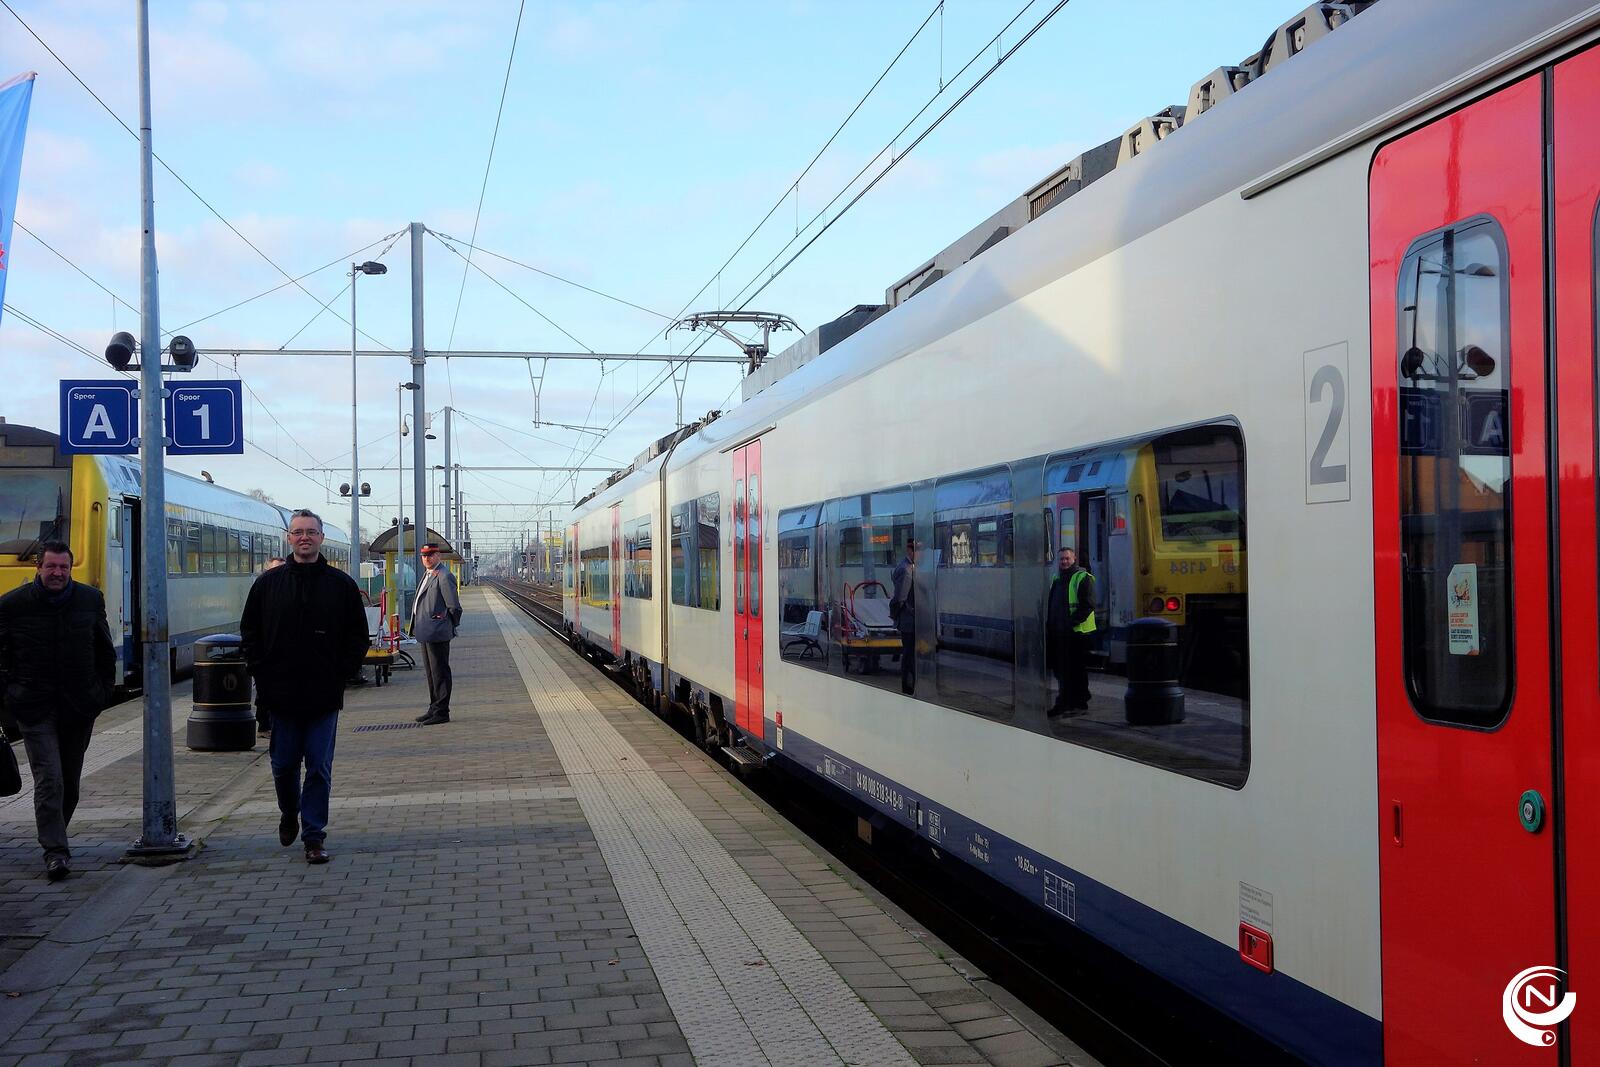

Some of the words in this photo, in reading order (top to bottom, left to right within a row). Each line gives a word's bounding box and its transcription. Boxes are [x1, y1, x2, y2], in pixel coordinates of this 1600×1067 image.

[73, 392, 96, 401] Spoor
[178, 394, 201, 402] Spoor
[82, 403, 117, 439] A
[192, 403, 210, 440] 1
[1310, 364, 1347, 485] 2
